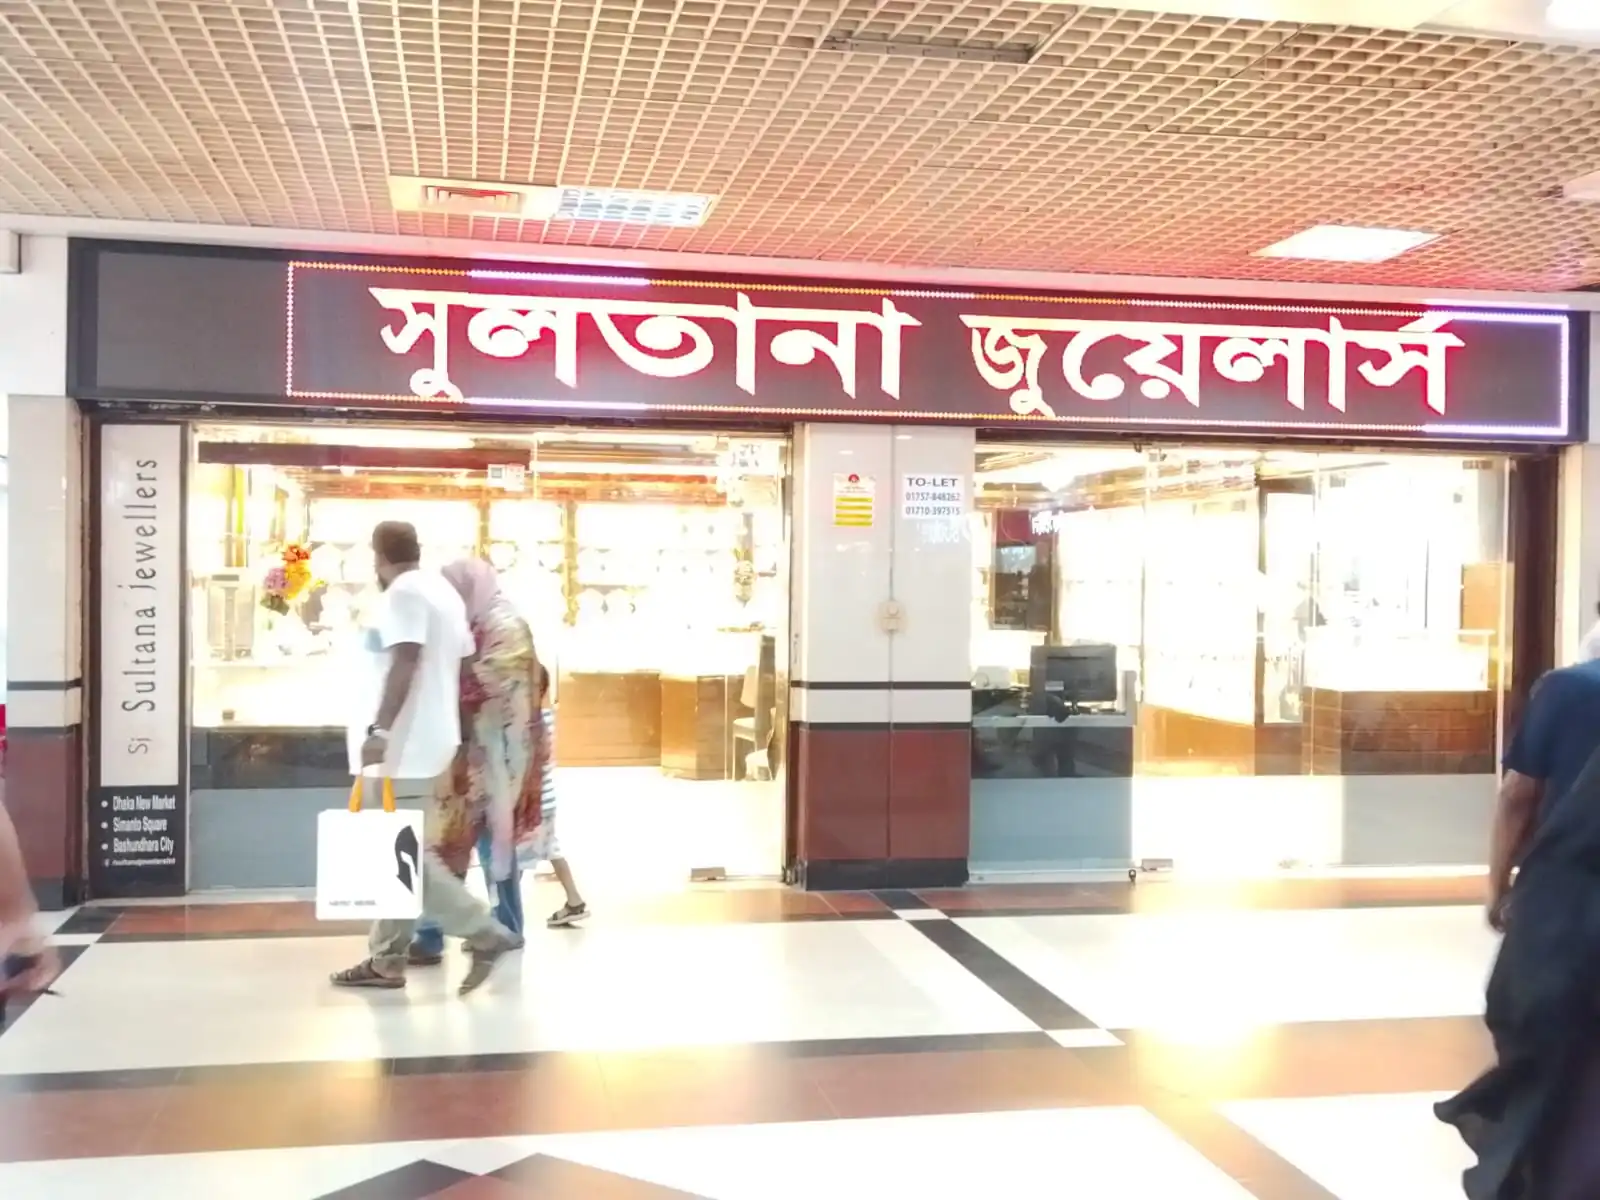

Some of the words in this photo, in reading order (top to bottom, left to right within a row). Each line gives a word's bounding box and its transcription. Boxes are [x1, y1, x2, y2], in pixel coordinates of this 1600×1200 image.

[369, 287, 923, 401] সুলতানা
[959, 312, 1466, 419] জুয়েলার্স
[906, 477, 959, 488] TO-LET
[117, 459, 158, 591] jewellers
[121, 605, 157, 712] Sultana
[112, 795, 135, 811] Dhaka
[136, 795, 151, 810] New
[152, 794, 176, 810] Market
[142, 815, 168, 835] Square
[160, 836, 174, 856] City
